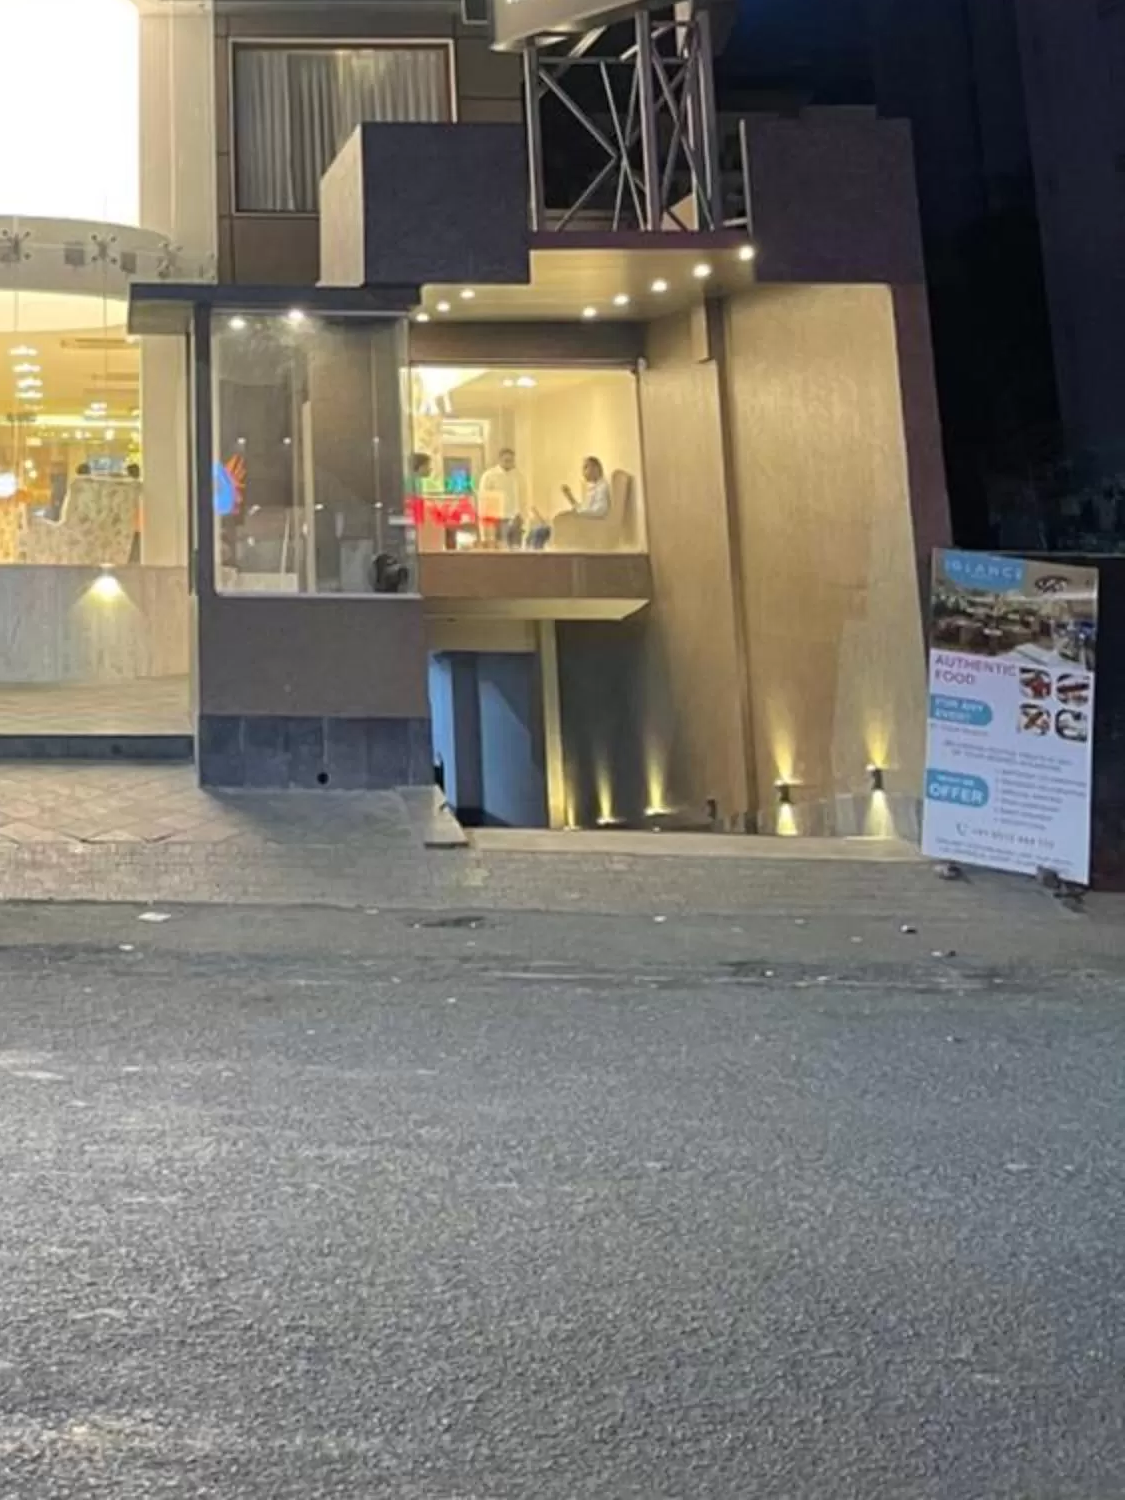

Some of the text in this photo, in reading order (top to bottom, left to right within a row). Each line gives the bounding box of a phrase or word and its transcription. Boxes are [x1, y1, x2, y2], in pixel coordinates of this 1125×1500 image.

[935, 654, 1016, 677] AUTHENTIC
[935, 668, 976, 685] FOOD
[928, 782, 984, 805] OFFER
